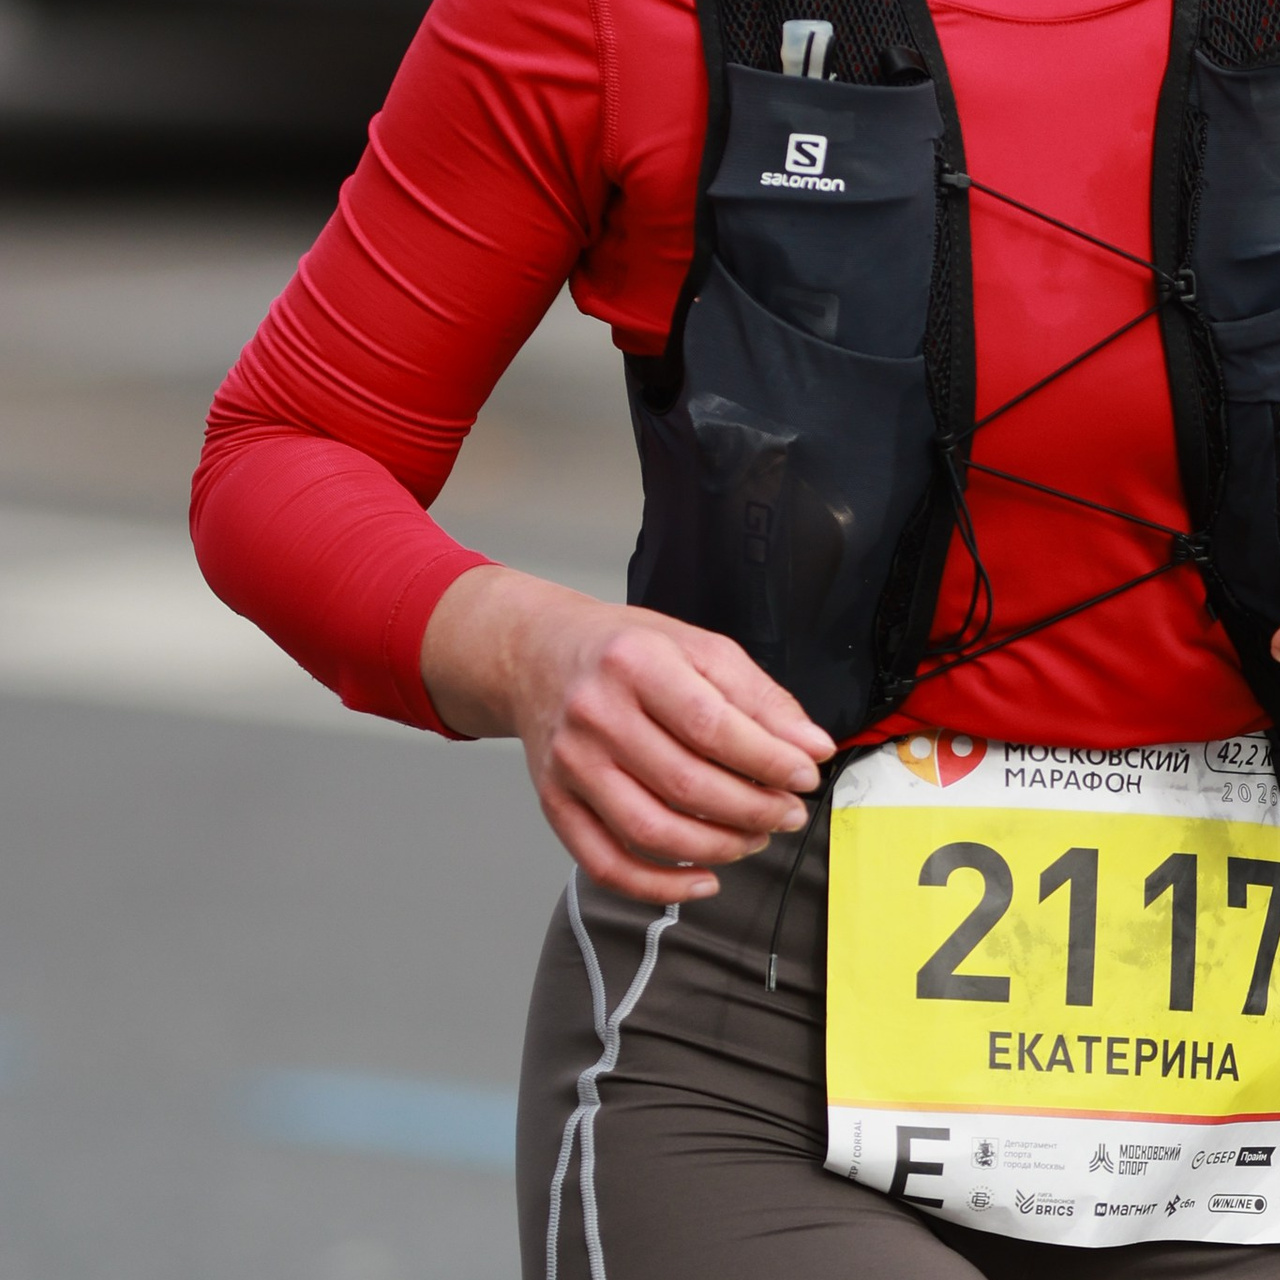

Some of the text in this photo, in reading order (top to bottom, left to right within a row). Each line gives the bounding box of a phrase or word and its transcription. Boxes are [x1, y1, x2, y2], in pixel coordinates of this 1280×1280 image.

[1004, 741, 1190, 773] МОСКОВСКИЙ
[1217, 741, 1259, 768] 42,2
[1005, 767, 1142, 793] МАРАФОН
[988, 1031, 1239, 1082] ЕКАТЕРИНА
[853, 1120, 862, 1158] CORRAL
[1004, 1140, 1057, 1150] Департамент
[1003, 1150, 1032, 1159] спорта
[1119, 1143, 1182, 1161] МОСКОВСКИЙ
[1206, 1151, 1267, 1165] СБЕР Прайм
[1003, 1160, 1065, 1171] города Москвы
[1118, 1161, 1149, 1176] СПОРТ
[1035, 1205, 1074, 1217] BRICS
[1212, 1198, 1253, 1210] WINLINE
